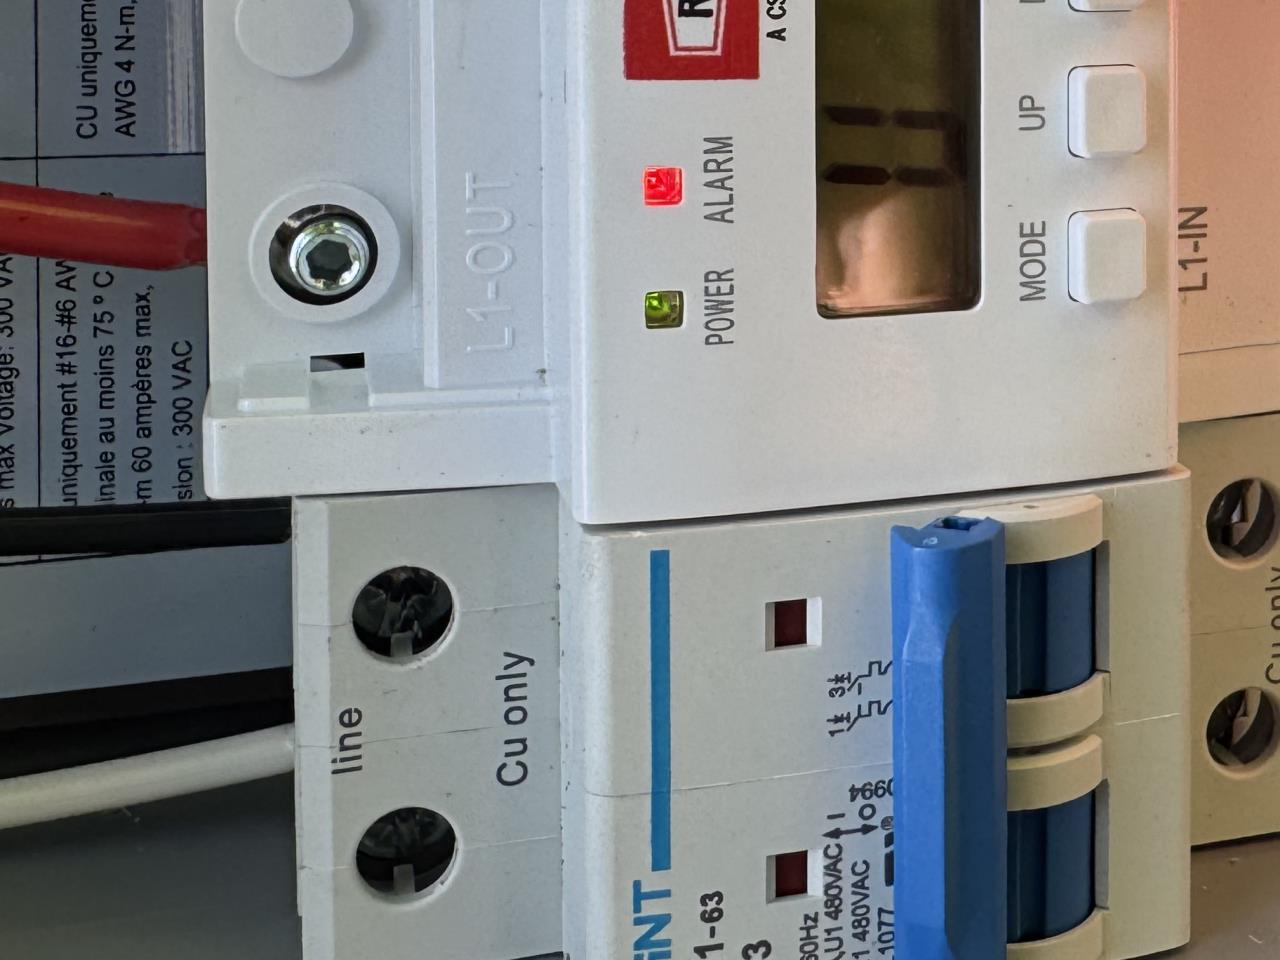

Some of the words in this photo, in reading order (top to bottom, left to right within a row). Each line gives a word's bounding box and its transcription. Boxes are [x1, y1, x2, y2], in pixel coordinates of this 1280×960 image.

[114, 0, 137, 51] N-m,
[766, 27, 787, 42] A
[114, 60, 136, 73] 4
[75, 105, 98, 139] CU
[114, 79, 136, 137] AWG
[1018, 94, 1046, 131] UP
[702, 136, 735, 224] ALARM
[0, 252, 13, 288] VA
[54, 258, 77, 292] AW
[465, 171, 515, 353] L1-OUT
[1018, 220, 1046, 302] MODE
[1177, 206, 1208, 293] L1-IN
[92, 271, 114, 288] C
[135, 284, 154, 337] max,
[703, 267, 735, 346] POWER
[93, 344, 115, 409] moins
[170, 340, 193, 390] VAC
[130, 345, 157, 439] ampères
[171, 397, 193, 436] 300
[98, 417, 115, 443] au
[0, 443, 14, 490] max
[93, 451, 115, 503] inale
[131, 446, 152, 473] 60
[171, 457, 193, 500] sion
[494, 651, 535, 726] only
[331, 707, 363, 775] line
[495, 736, 528, 787] Cu
[822, 843, 844, 920] 480VAC
[850, 859, 870, 942] 480VAC
[692, 890, 725, 960] 1-63
[877, 907, 894, 960] 1077
